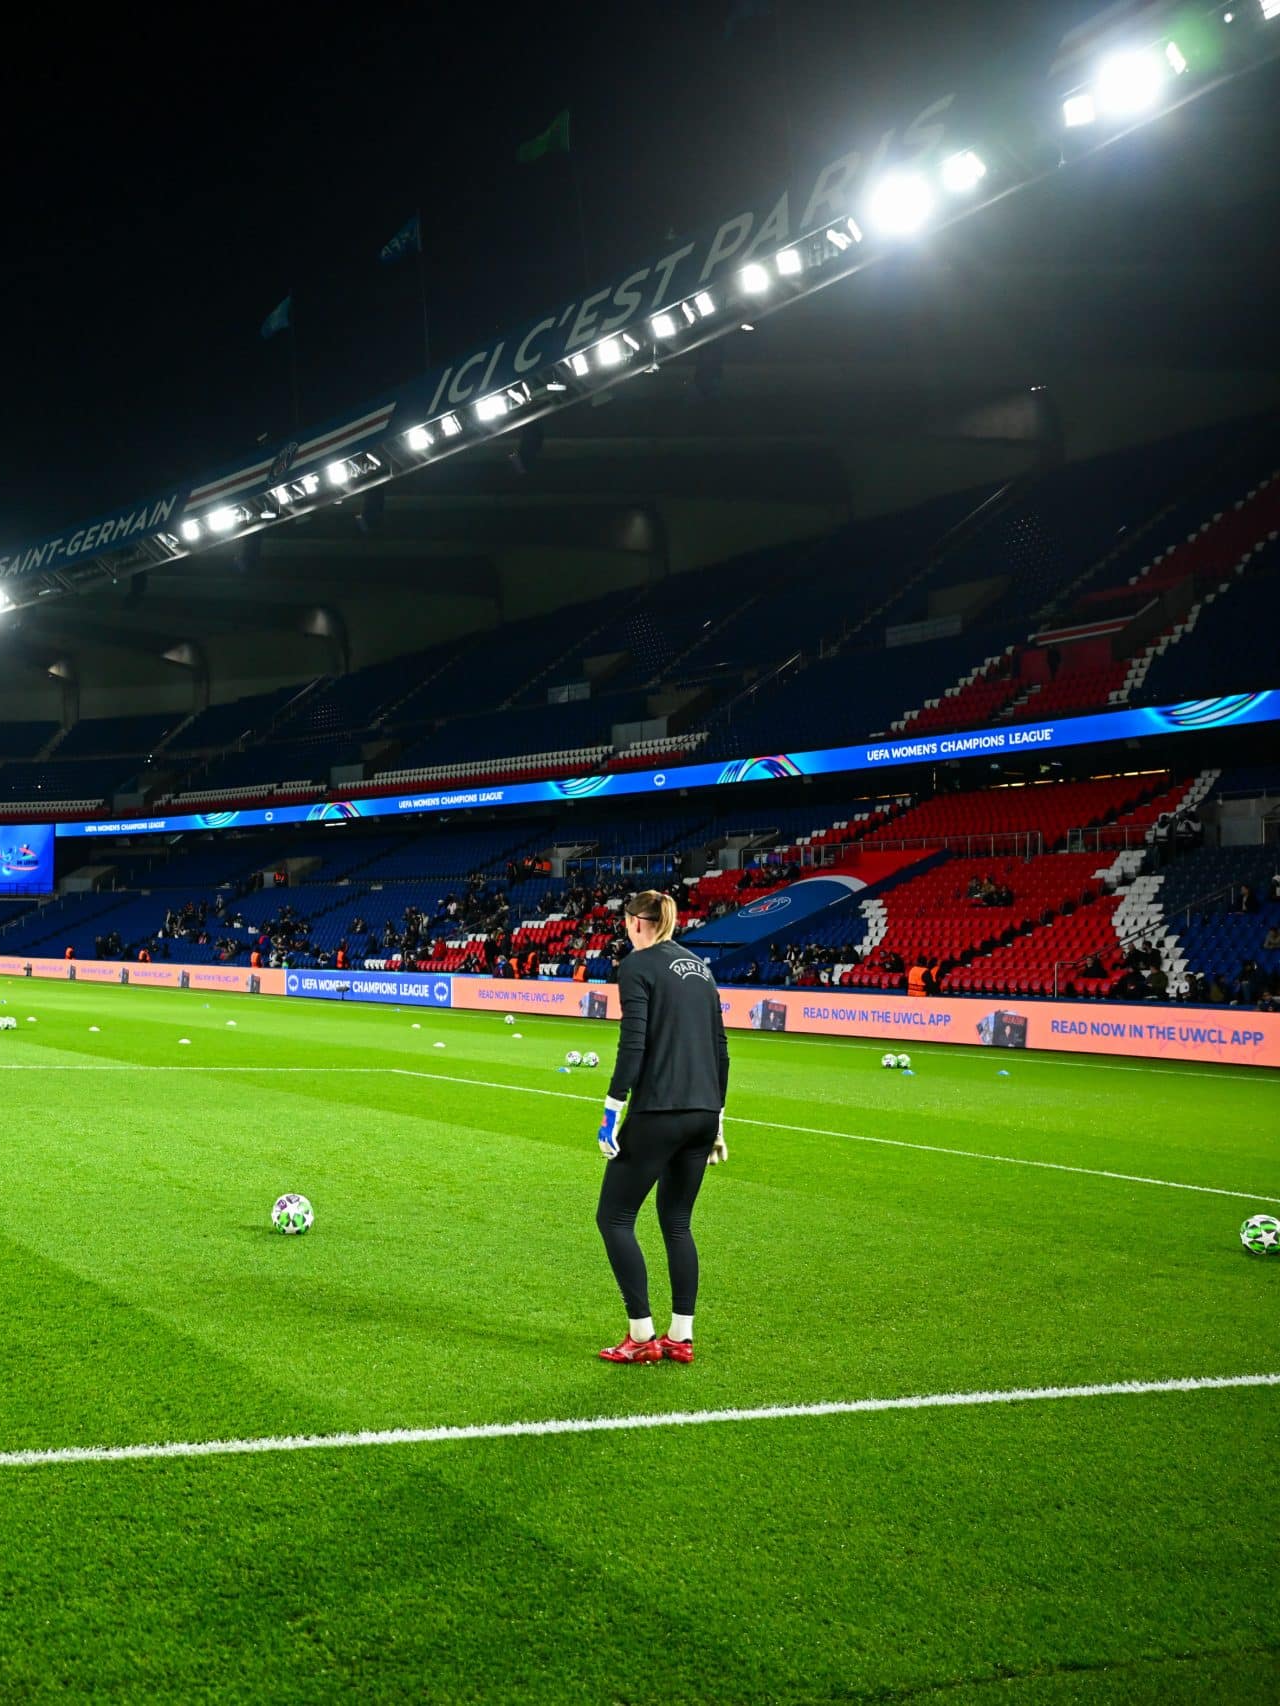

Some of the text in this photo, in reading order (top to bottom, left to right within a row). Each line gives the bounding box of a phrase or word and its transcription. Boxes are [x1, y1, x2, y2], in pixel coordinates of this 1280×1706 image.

[426, 92, 956, 416] ICI C'EST PARIS
[866, 749, 890, 761] UEFA
[891, 743, 938, 758] WOMEN'S
[940, 734, 1005, 753] CHAMPIONS
[440, 794, 478, 805] CHAMPIONS
[673, 961, 710, 979] PARIS
[301, 978, 318, 990] UEFA
[352, 980, 398, 995] CHAMPIONS
[399, 983, 430, 997] LEAGUE
[802, 1007, 951, 1027] READ NOW IN THE UWCL APP
[1050, 1019, 1265, 1046] READ NOW IN THE UWCL APP
